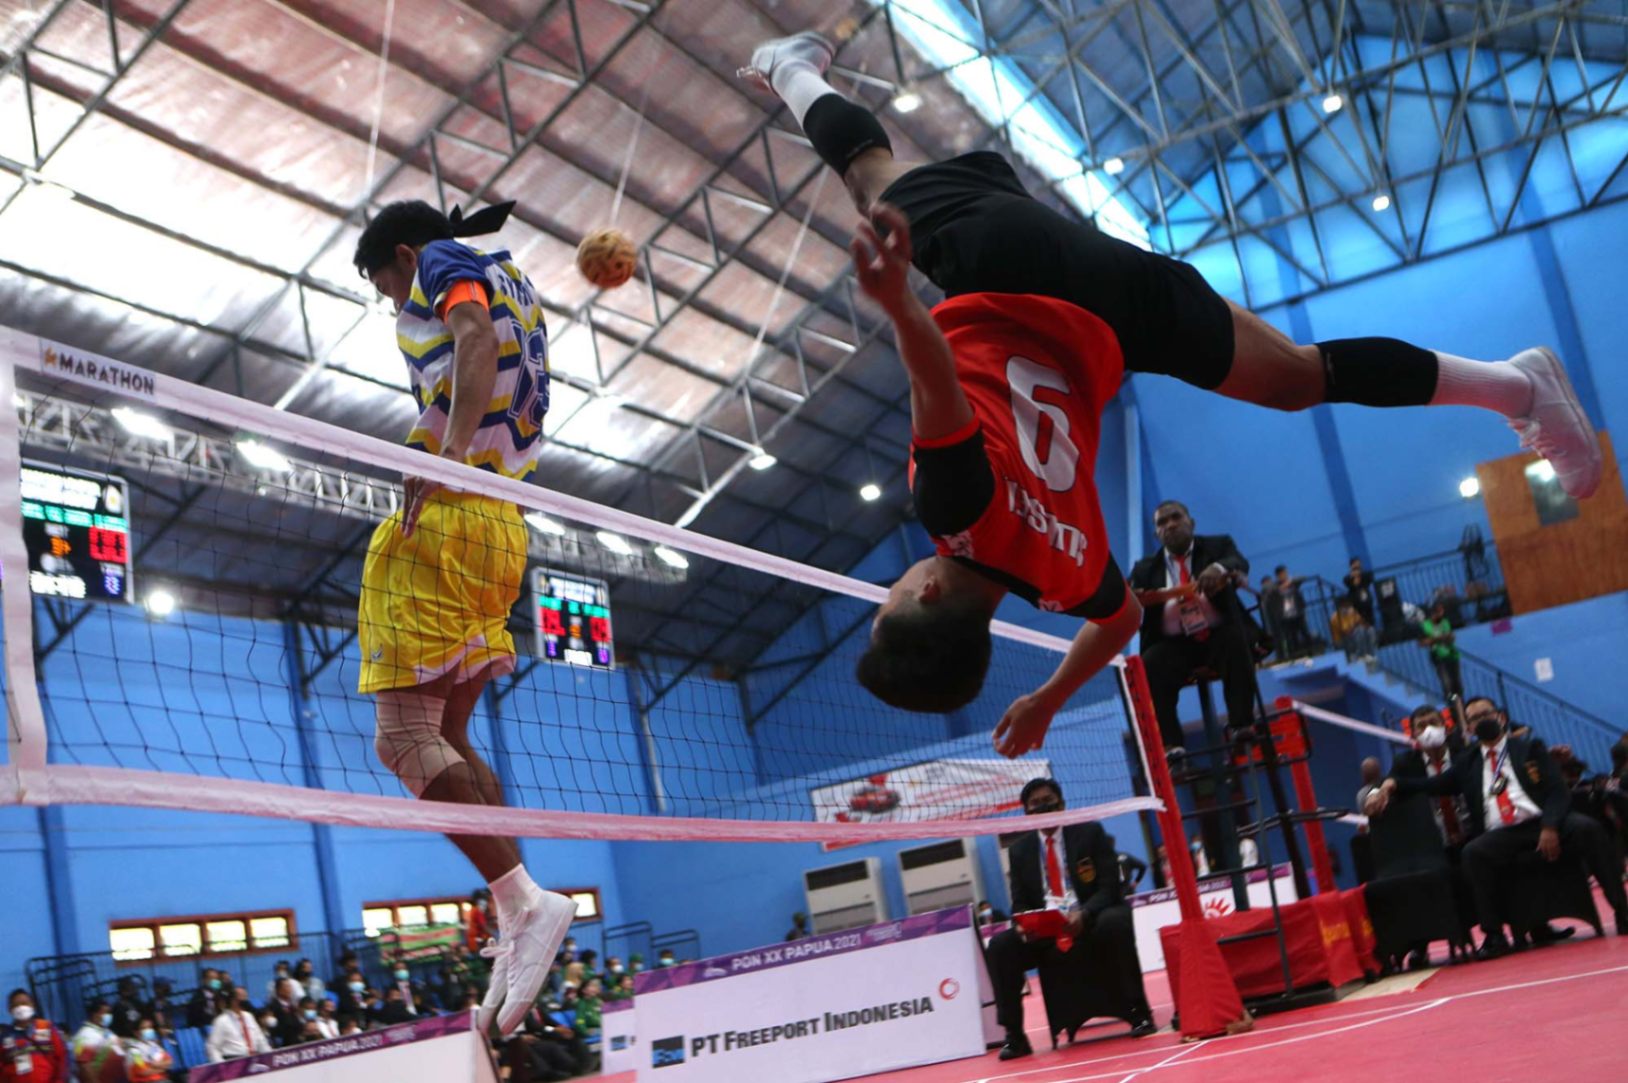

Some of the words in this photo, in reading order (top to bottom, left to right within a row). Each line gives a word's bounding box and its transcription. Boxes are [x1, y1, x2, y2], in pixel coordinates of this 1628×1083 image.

[60, 352, 154, 395] MARATHON
[731, 954, 762, 971] PON
[764, 950, 784, 964] XX
[785, 939, 833, 960] PAPUA
[834, 933, 862, 949] 2021
[691, 1033, 720, 1057] PT
[724, 1017, 821, 1051] FREEPORT
[824, 996, 935, 1033] INDONESIA
[272, 1052, 299, 1067] PON
[318, 1039, 358, 1056] PAPUA
